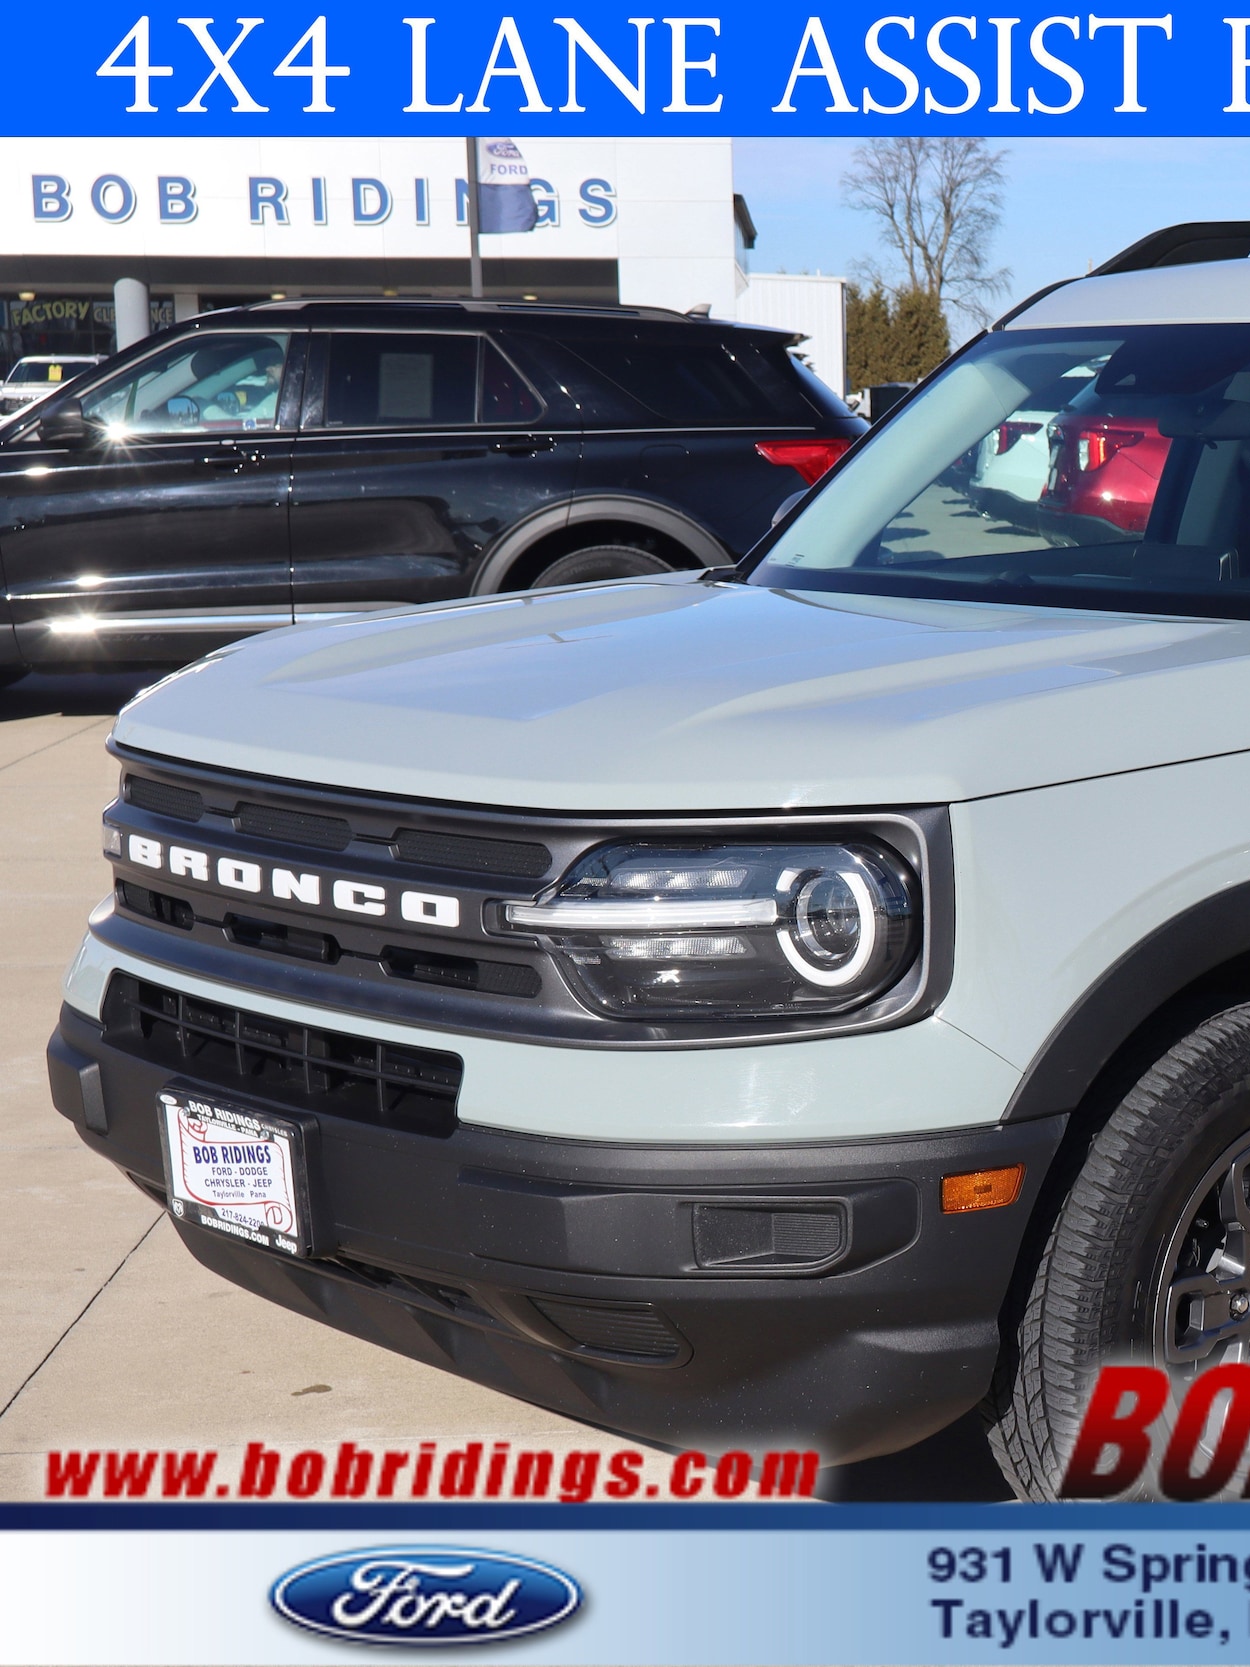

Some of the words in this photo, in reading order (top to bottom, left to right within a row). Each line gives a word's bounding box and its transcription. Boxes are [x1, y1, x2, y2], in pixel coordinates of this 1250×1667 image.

[490, 163, 528, 175] FORD
[32, 175, 198, 222] BOB
[11, 301, 90, 326] FACTORY
[93, 305, 174, 324] CLENCE
[127, 833, 461, 929] BRONCO
[187, 1100, 212, 1118] BOB
[214, 1107, 261, 1132] RIDINGS
[193, 1146, 218, 1165] BOB
[221, 1145, 271, 1165] RIDINGS
[212, 1166, 232, 1176] FORD
[239, 1167, 268, 1177] DODGE
[204, 1178, 246, 1188] CHRYSLER
[252, 1179, 273, 1188] JEEP
[212, 1190, 245, 1200] Taylorville
[250, 1191, 267, 1199] Pana
[200, 1214, 270, 1247] BOBRIDINGS.COM
[275, 1233, 298, 1255] Jeep
